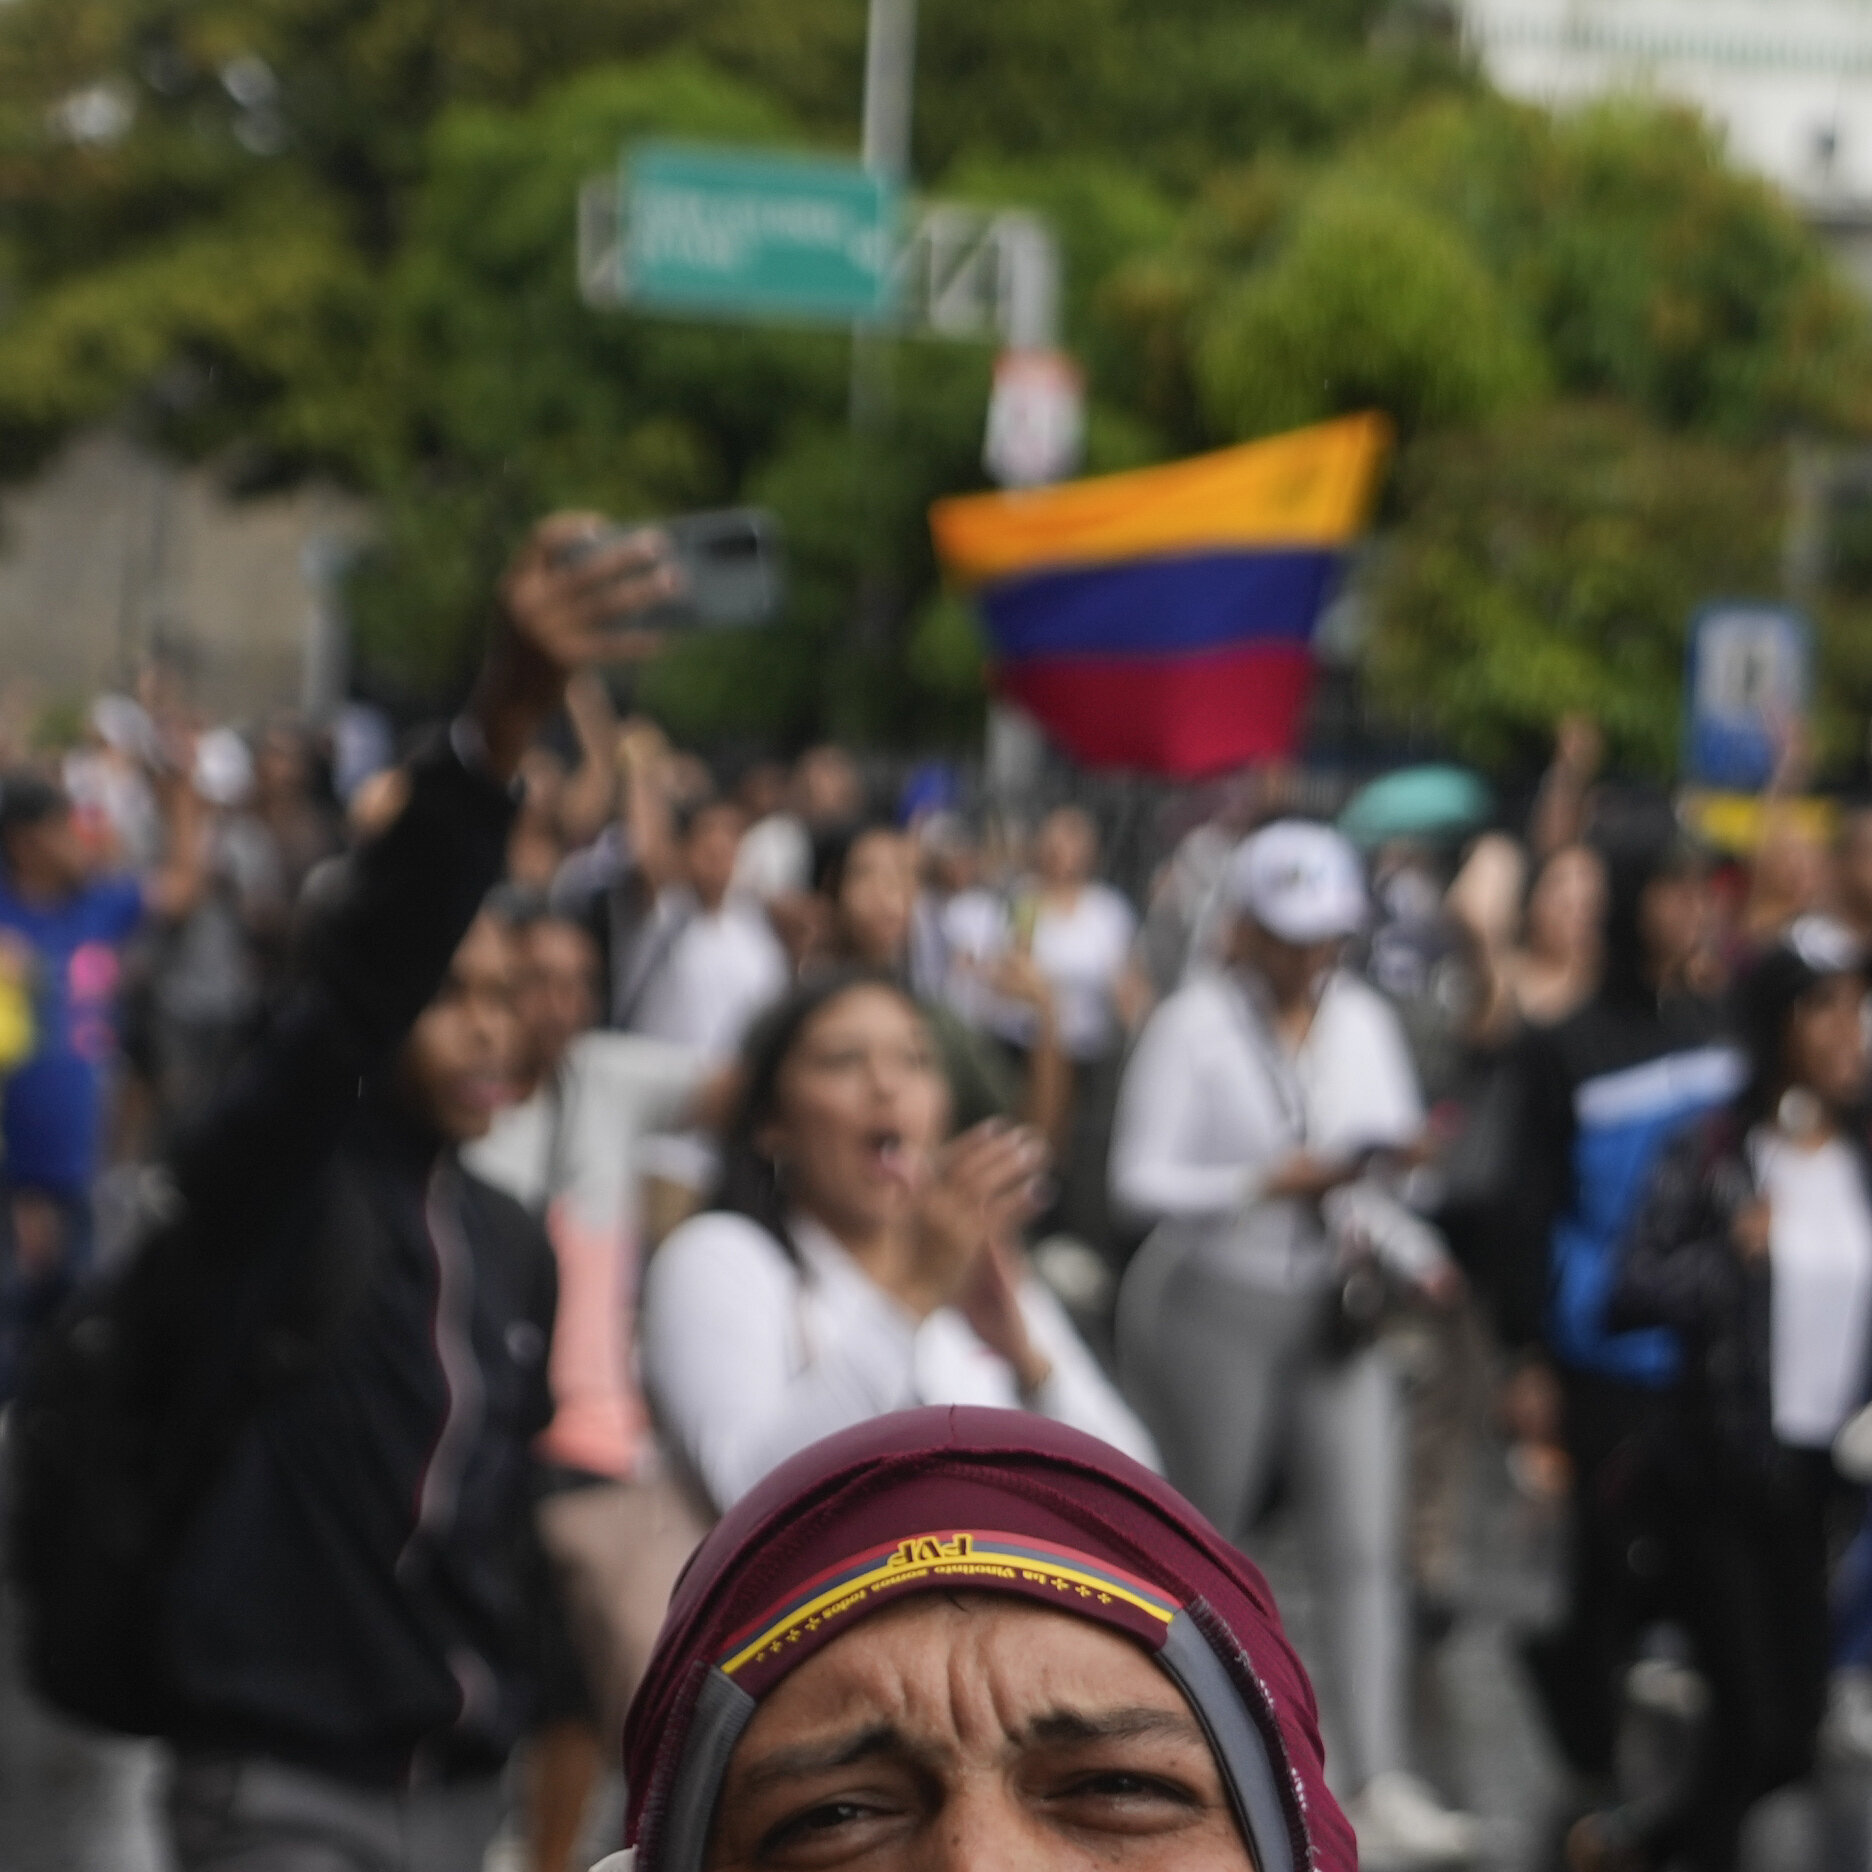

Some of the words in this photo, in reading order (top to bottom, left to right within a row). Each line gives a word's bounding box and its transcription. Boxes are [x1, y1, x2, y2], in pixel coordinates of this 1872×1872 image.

[888, 1533, 973, 1568] FVF
[870, 1567, 929, 1593] somos
[934, 1564, 1016, 1580] Vinotinto
[822, 1589, 867, 1619] todos
